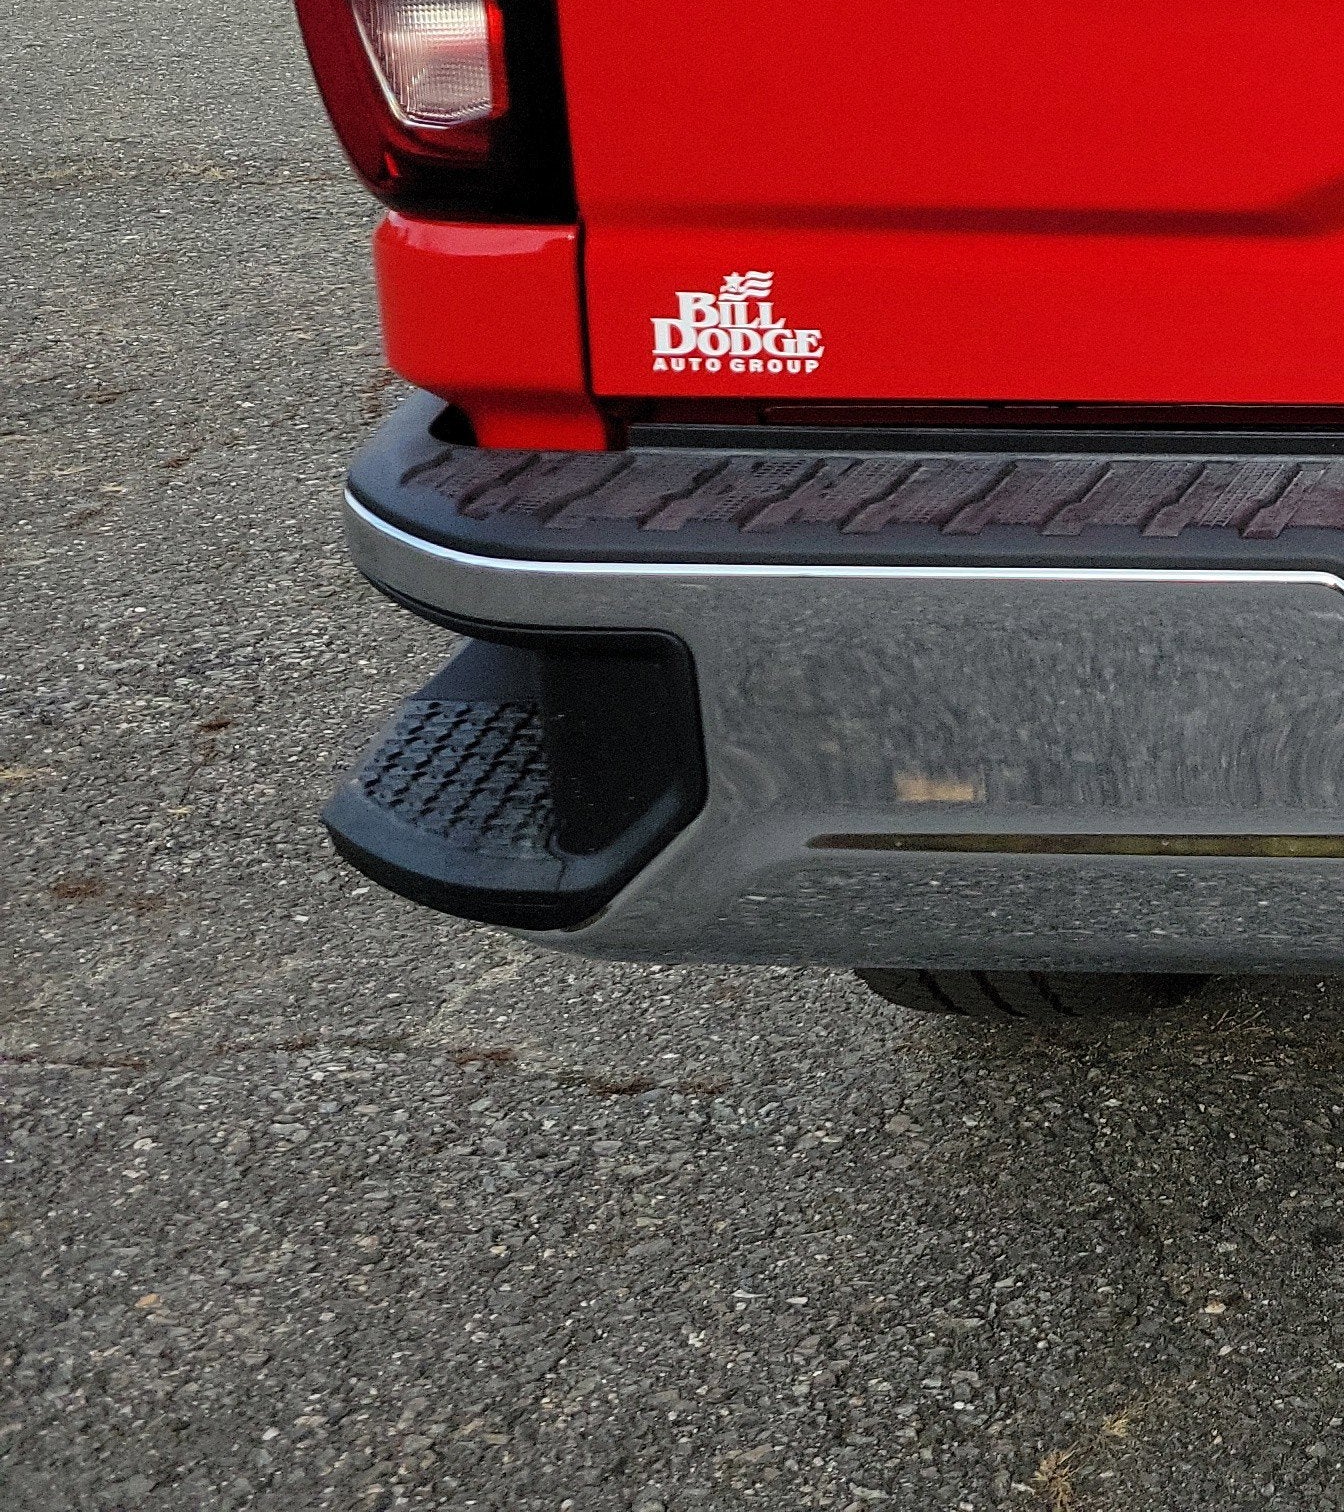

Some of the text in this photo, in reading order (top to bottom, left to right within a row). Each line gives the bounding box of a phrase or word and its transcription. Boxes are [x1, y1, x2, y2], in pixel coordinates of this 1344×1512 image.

[676, 291, 786, 329] BILL
[651, 318, 825, 358] DODGE
[653, 358, 820, 374] AUTO GROUP
